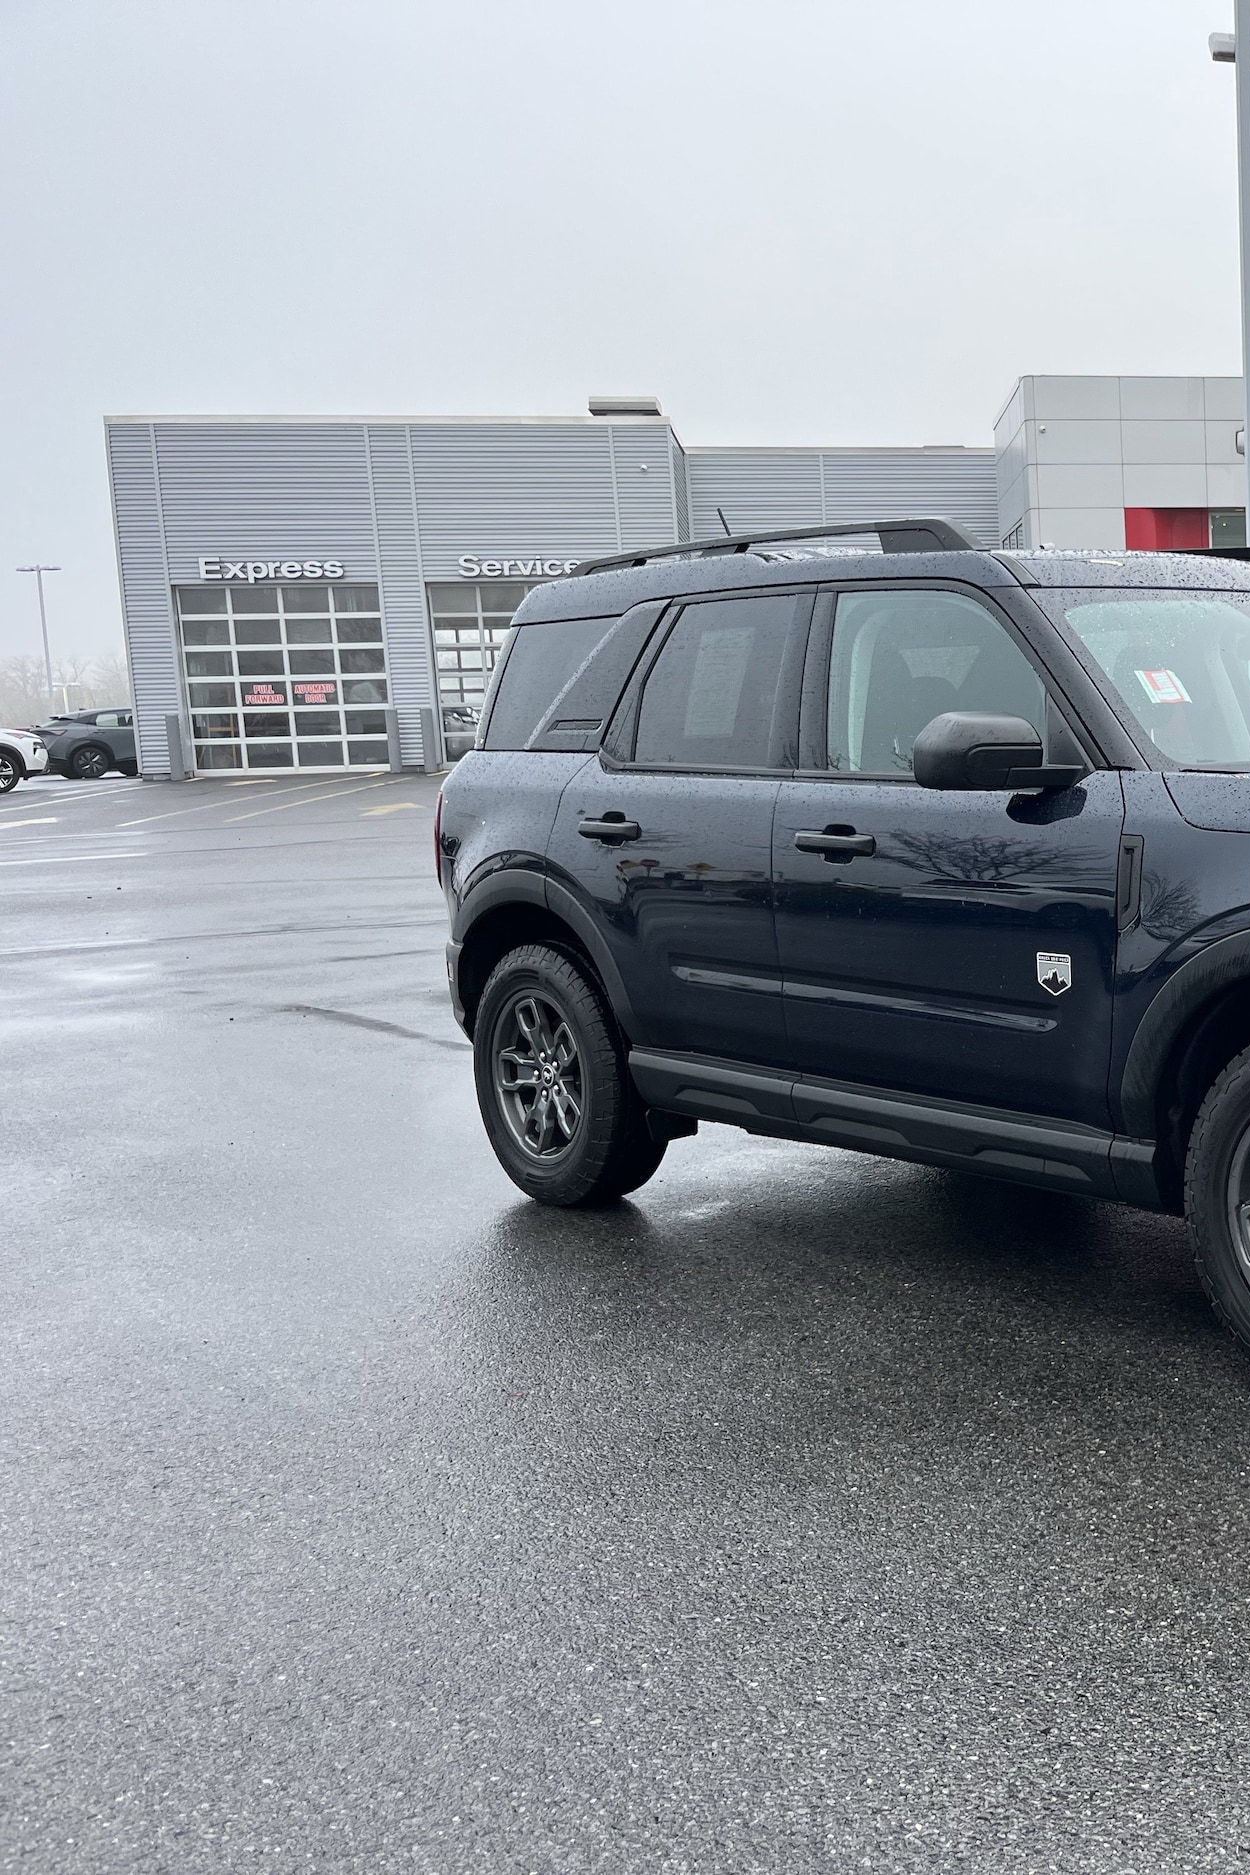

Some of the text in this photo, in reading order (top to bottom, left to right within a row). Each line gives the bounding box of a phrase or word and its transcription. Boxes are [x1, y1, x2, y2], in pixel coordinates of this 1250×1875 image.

[198, 557, 344, 583] Express
[458, 555, 582, 577] Service
[253, 684, 275, 694] PULL
[294, 683, 336, 694] AUTOMATIC
[245, 694, 284, 704] FORWARD
[305, 693, 327, 703] DOOR
